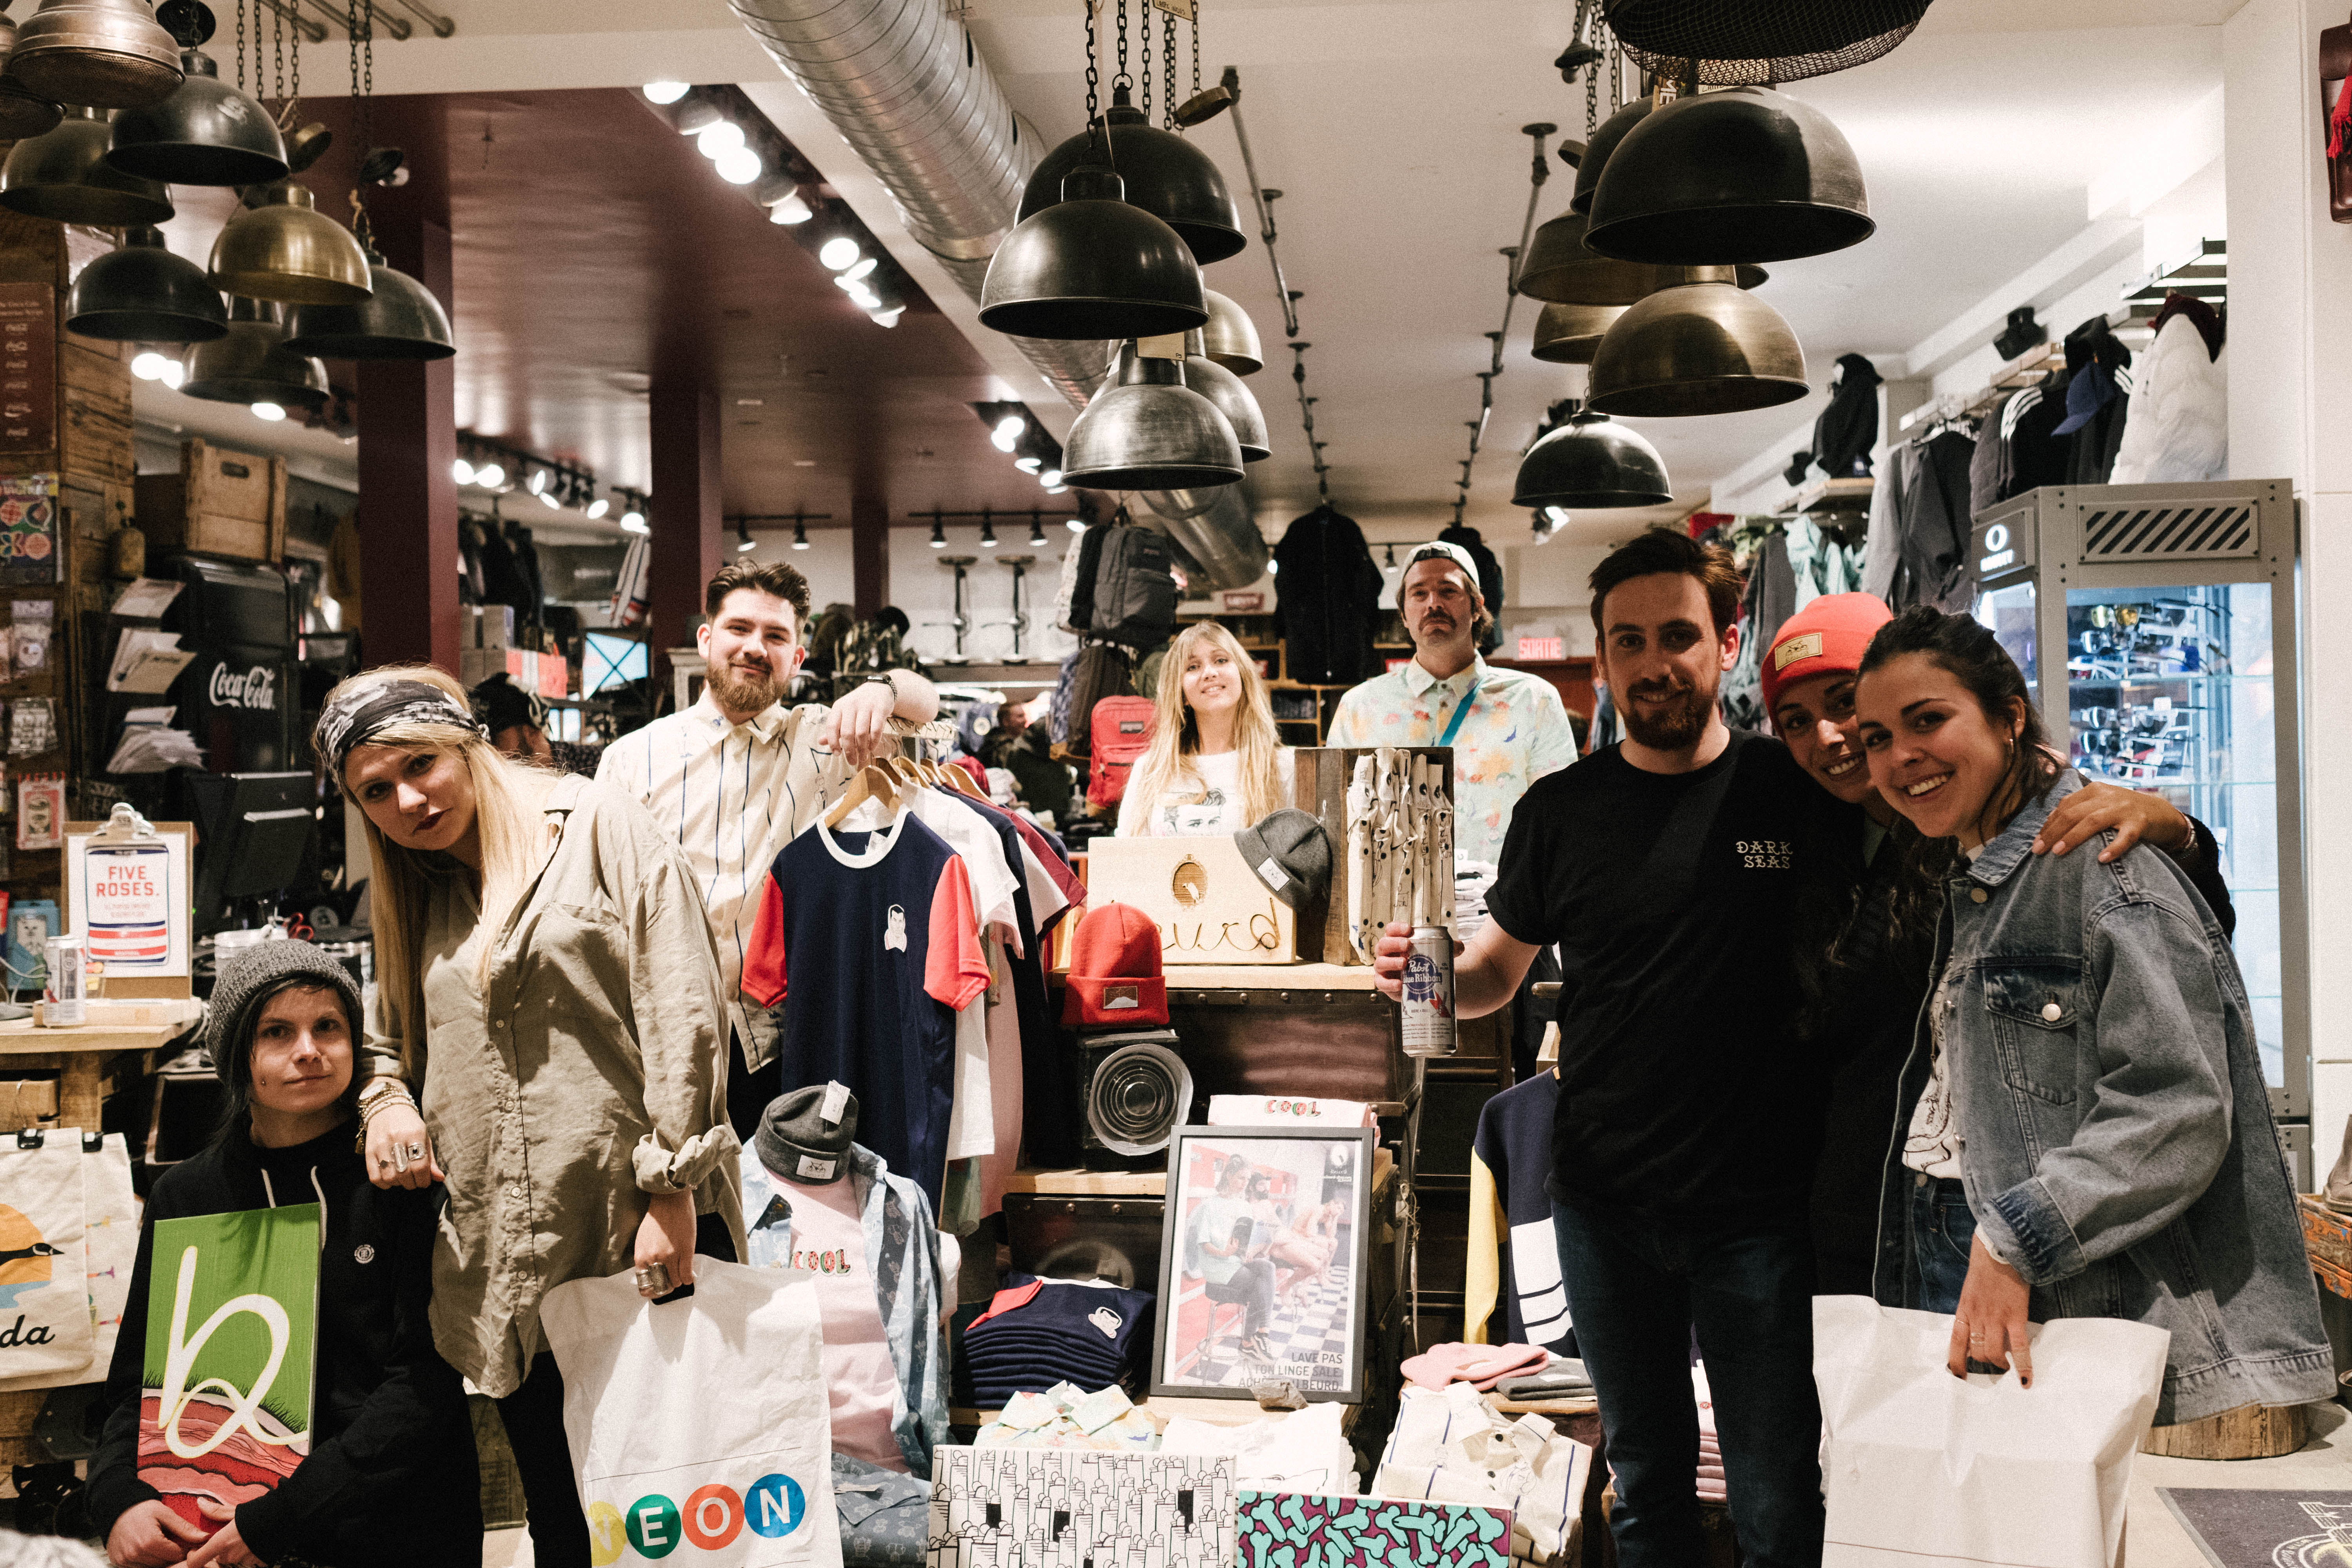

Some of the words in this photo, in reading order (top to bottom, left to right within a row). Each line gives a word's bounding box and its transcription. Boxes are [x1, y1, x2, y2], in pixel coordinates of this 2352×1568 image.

[1519, 637, 1562, 659] SORTIE
[1736, 841, 1793, 855] DARK
[1744, 855, 1790, 869] SEAS
[108, 866, 146, 880] FIVE
[1408, 960, 1430, 973] Pabst
[1415, 973, 1441, 982] Ribbon
[1264, 1100, 1321, 1117] COOL
[790, 1249, 851, 1274] COOL
[1292, 1352, 1319, 1363] LAVE
[1322, 1354, 1343, 1364] PAS
[1255, 1365, 1274, 1374] TON
[1278, 1365, 1309, 1376] LINGE
[1302, 1379, 1341, 1391] BEURD.
